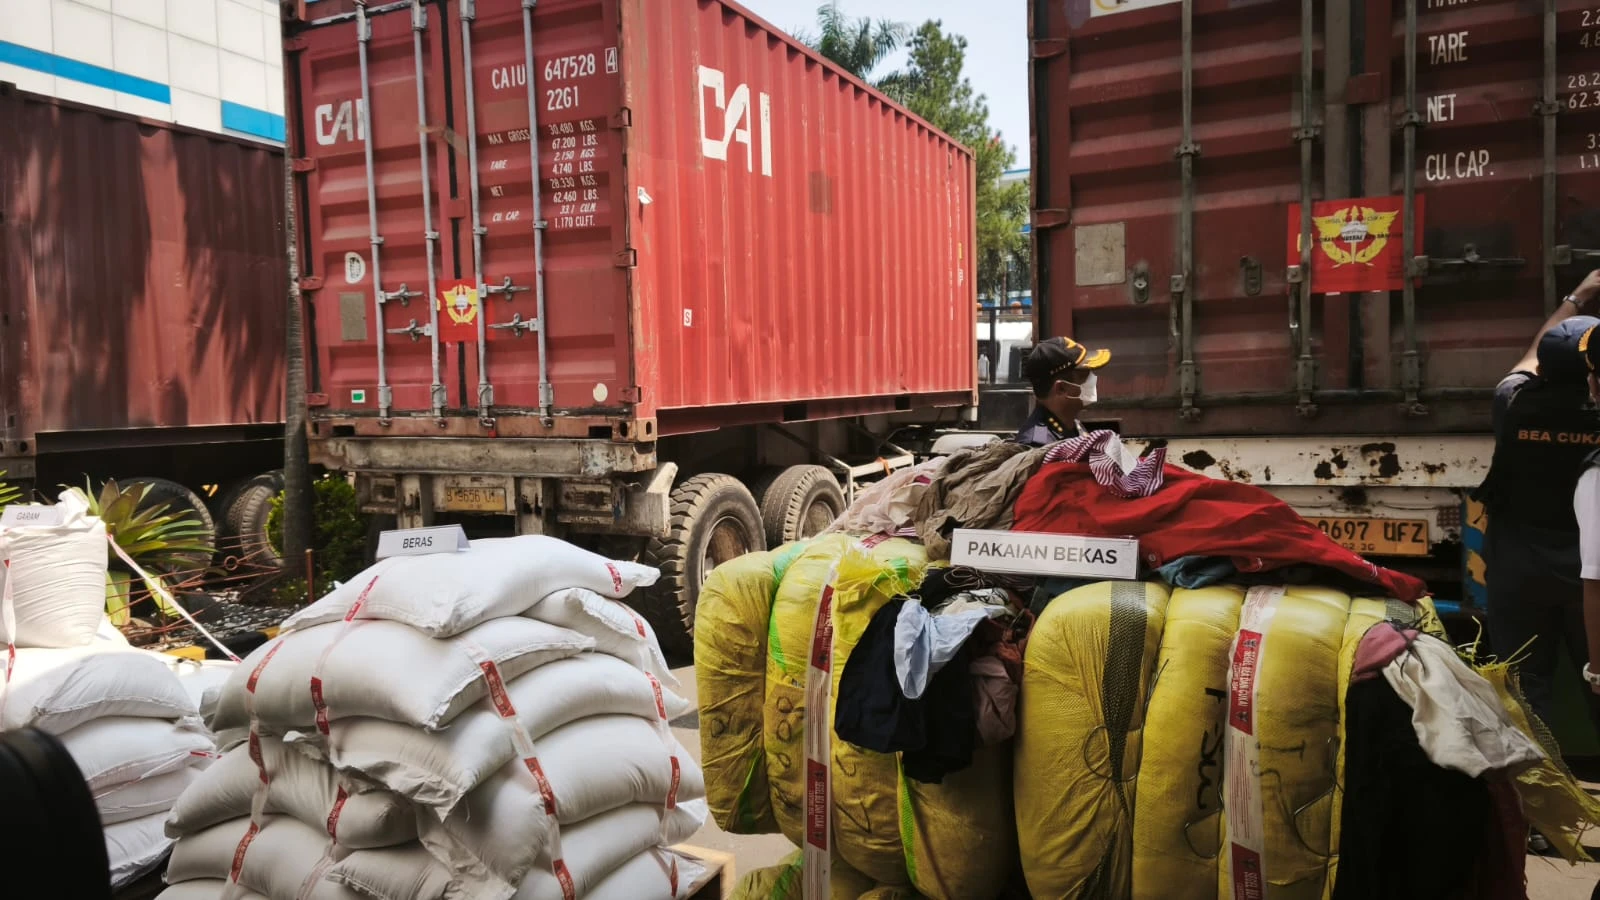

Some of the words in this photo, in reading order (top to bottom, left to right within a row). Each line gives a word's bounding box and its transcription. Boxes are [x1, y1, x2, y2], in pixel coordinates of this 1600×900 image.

[1428, 31, 1469, 65] TARE
[491, 64, 526, 90] CAIU
[544, 53, 596, 82] 647528
[606, 48, 618, 72] 4
[546, 86, 579, 111] 22G1
[1427, 94, 1456, 123] NET
[698, 64, 772, 177] CAI
[487, 133, 504, 145] MAX
[507, 129, 531, 143] GROSS
[548, 122, 575, 136] 30.480
[551, 137, 576, 150] 67.200
[582, 134, 599, 147] LBS.
[552, 162, 573, 175] 4.740
[1425, 154, 1451, 181] CU.
[1455, 150, 1494, 178] CAP.
[490, 186, 504, 197] NET
[549, 176, 575, 189] 28.330
[553, 191, 577, 203] 62.460
[554, 216, 573, 229] 1.170
[1518, 429, 1552, 442] BEA
[402, 536, 433, 549] BERAS
[1383, 521, 1425, 543] UFZ
[967, 541, 1048, 561] PAKAIAN
[1053, 546, 1117, 565] BEKAS
